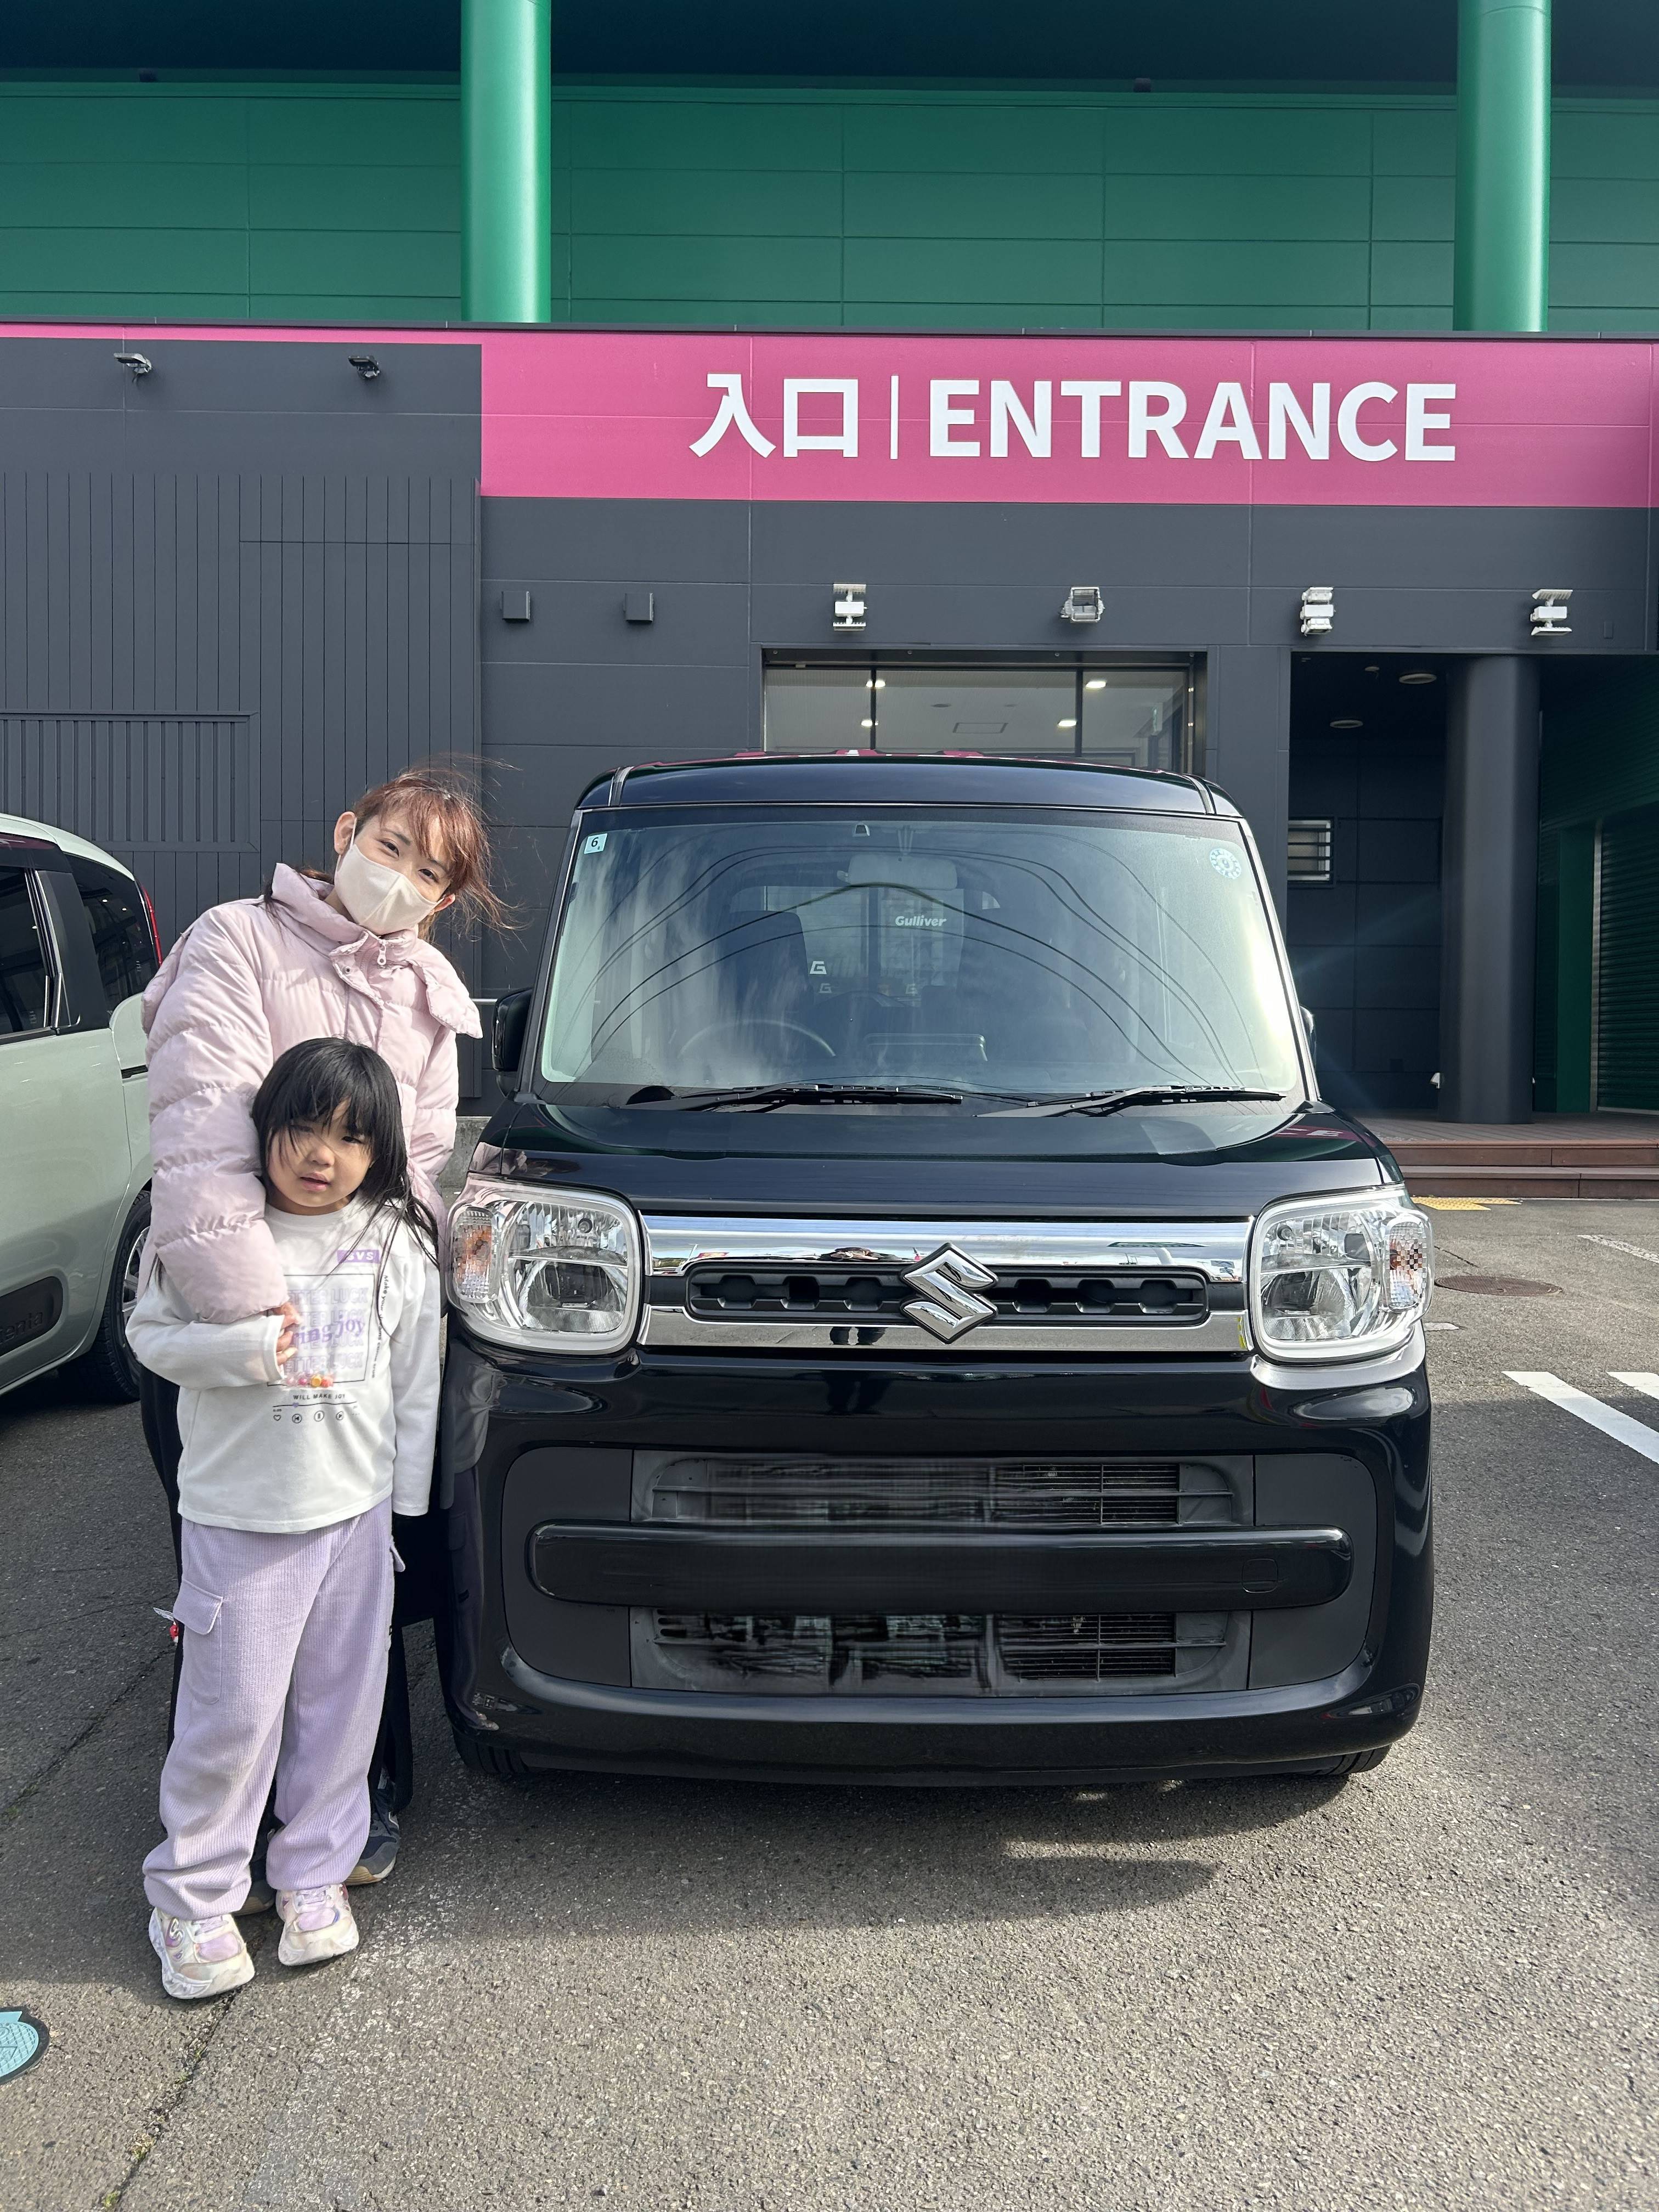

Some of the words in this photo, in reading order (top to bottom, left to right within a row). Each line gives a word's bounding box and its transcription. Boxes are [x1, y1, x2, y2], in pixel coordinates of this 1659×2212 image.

[689, 374, 859, 460] 入口
[929, 380, 1456, 462] ENTRANCE
[591, 837, 599, 847] 6
[895, 915, 947, 927] Gulliver
[331, 1288, 369, 1304] LUCK
[291, 1324, 332, 1345] ring
[335, 1314, 365, 1339] joy
